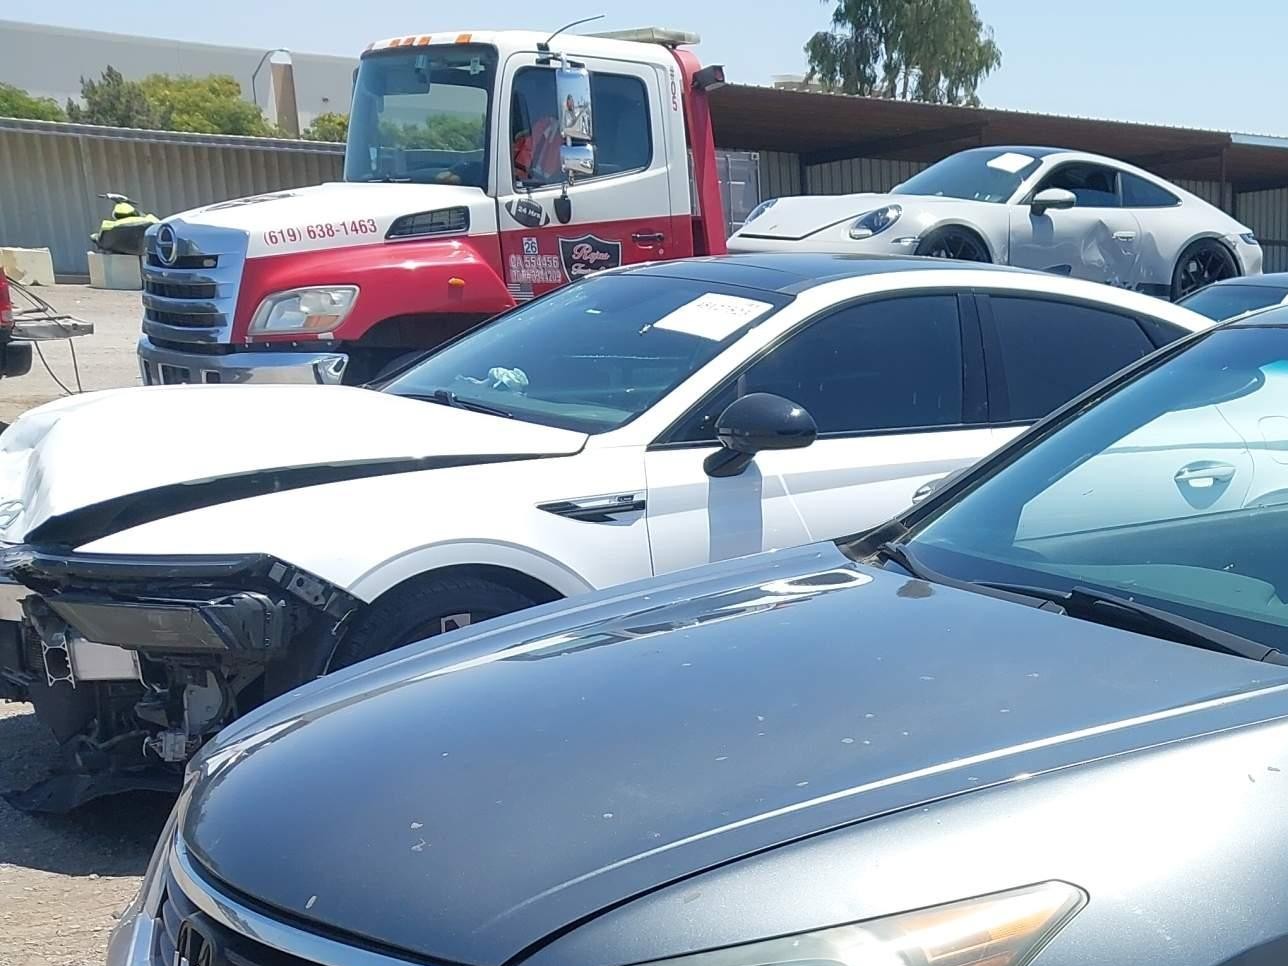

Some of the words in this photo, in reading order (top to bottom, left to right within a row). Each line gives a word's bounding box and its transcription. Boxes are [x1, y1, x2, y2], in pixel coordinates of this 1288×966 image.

[518, 205, 527, 214] 24
[263, 226, 302, 246] (619)
[306, 218, 377, 240] 638-1463
[524, 241, 538, 254] 26
